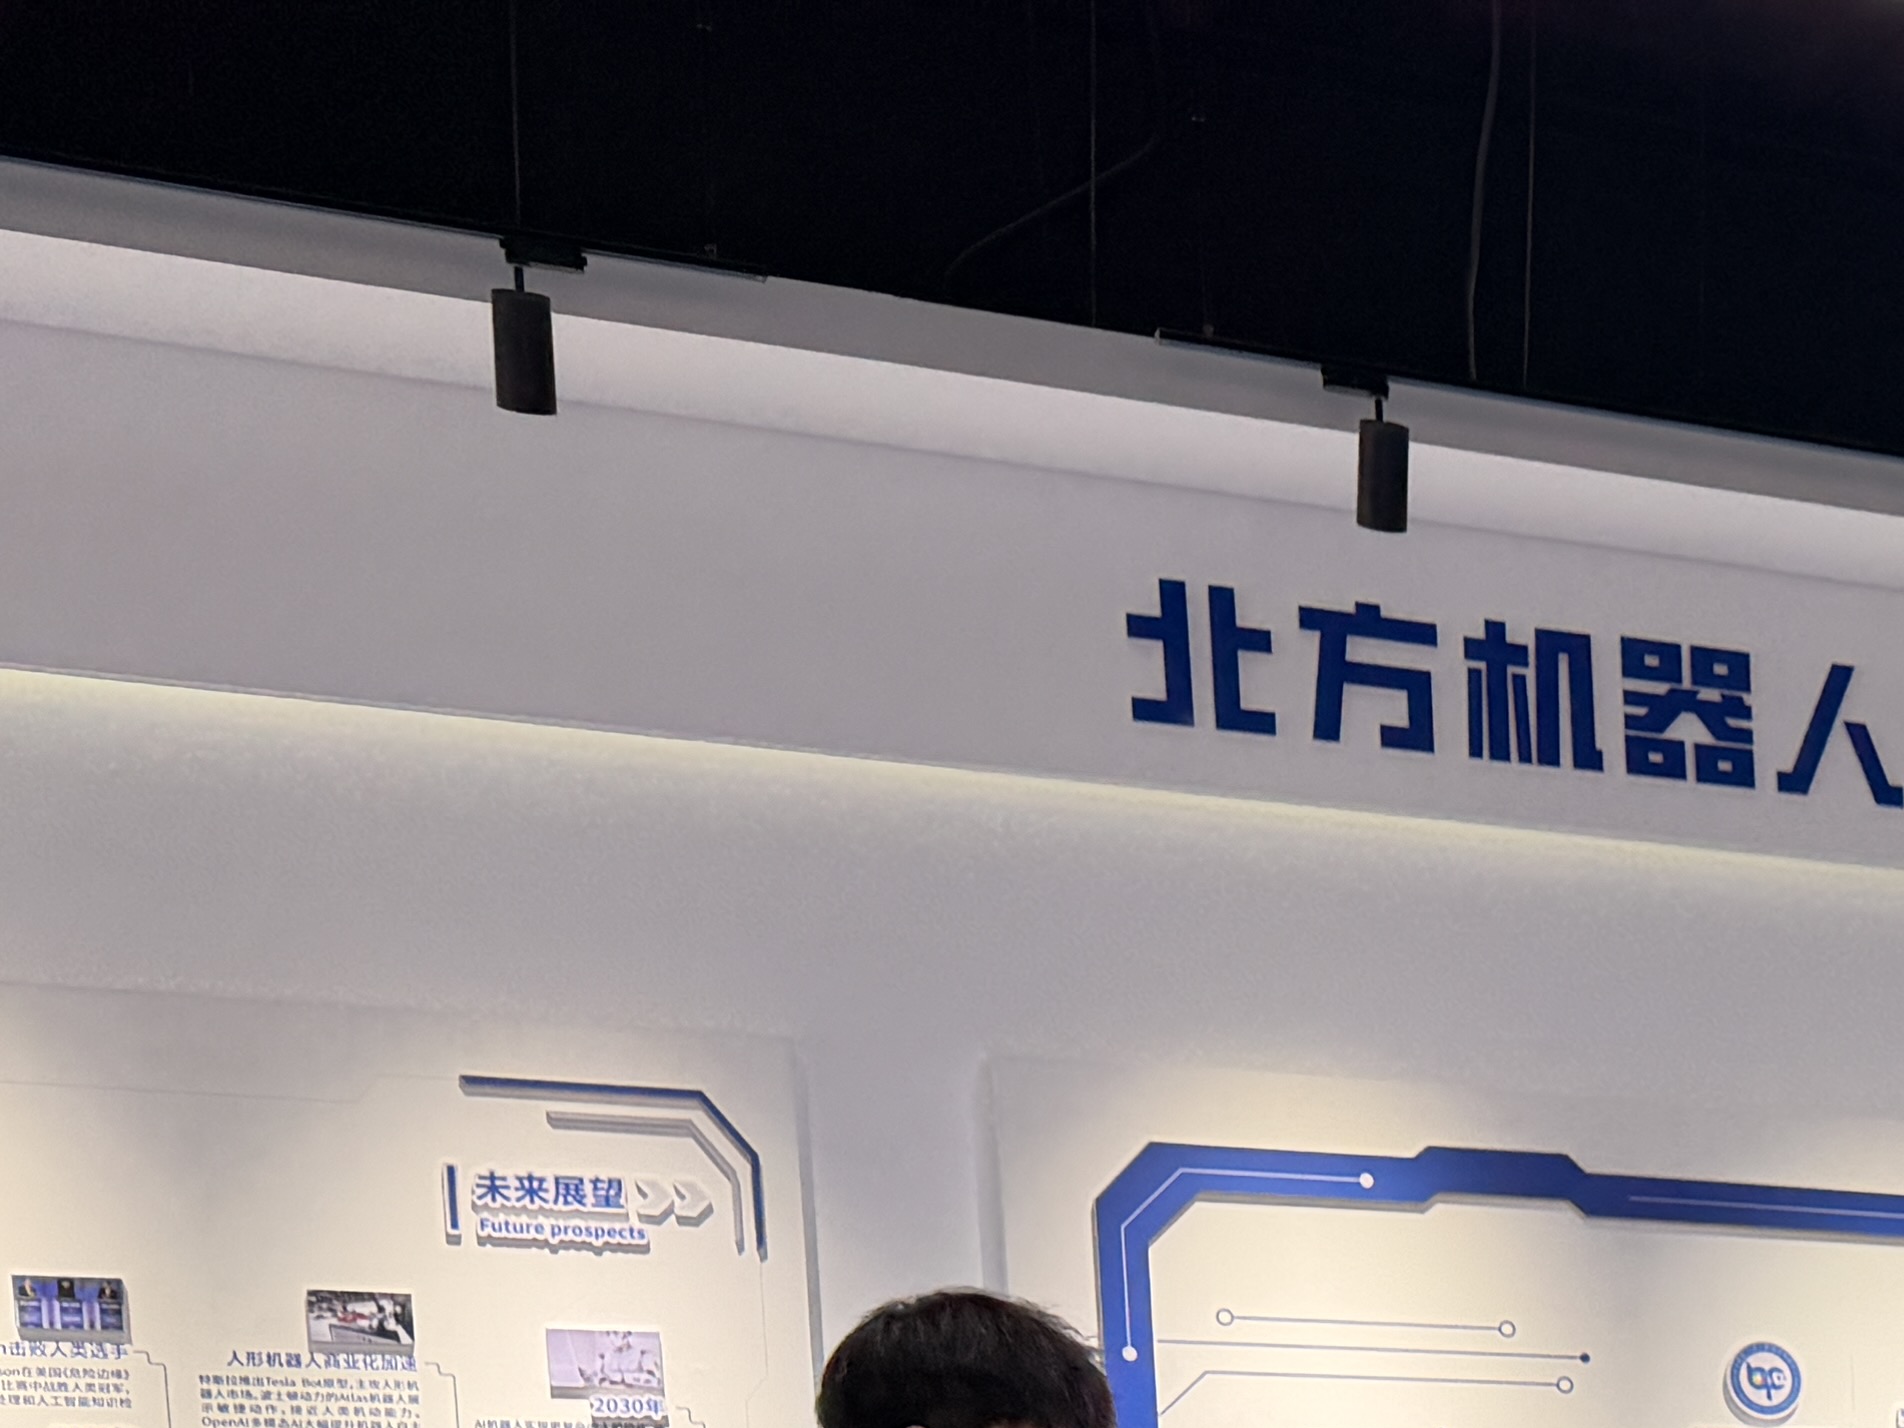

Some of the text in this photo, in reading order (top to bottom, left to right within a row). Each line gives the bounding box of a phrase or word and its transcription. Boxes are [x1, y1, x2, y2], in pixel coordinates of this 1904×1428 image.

[475, 1171, 626, 1209] 未来展望
[480, 1217, 647, 1244] Future prospects
[593, 1397, 664, 1415] 2030年
